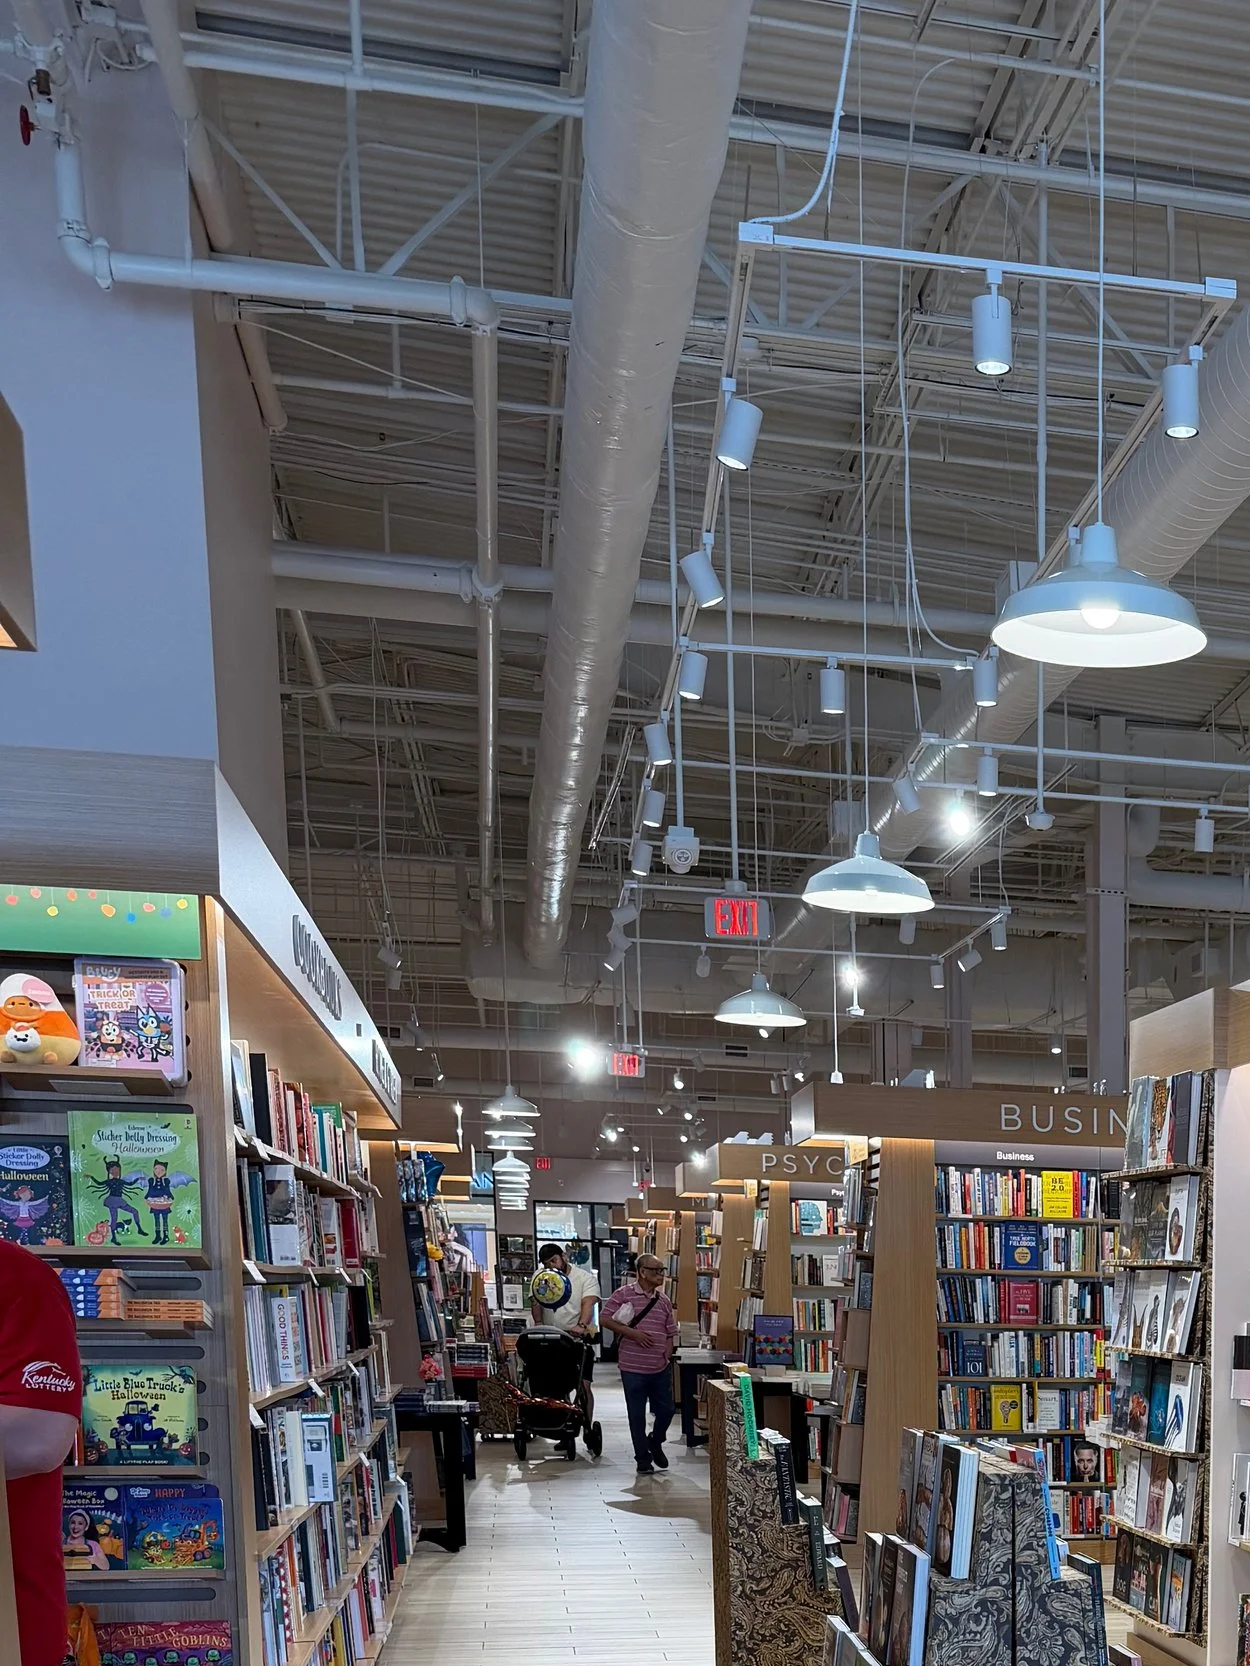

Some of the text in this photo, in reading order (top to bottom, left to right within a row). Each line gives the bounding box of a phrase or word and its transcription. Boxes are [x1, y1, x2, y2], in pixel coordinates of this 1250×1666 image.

[714, 899, 759, 936] EXIT
[90, 989, 136, 999] TRICK OR
[613, 1053, 638, 1075] EXIT
[1000, 1103, 1128, 1135] BUSIN
[97, 1130, 177, 1145] Sticker Dolly Dressing
[112, 1141, 164, 1153] Halloween
[5, 1159, 38, 1167] Dressing
[26, 1153, 44, 1162] Dolly
[996, 1152, 1035, 1162] Business
[762, 1153, 843, 1176] PSYC
[277, 1303, 290, 1361] GOOD THINGS
[967, 1362, 982, 1373] 101
[21, 1372, 76, 1391] Kentucky
[26, 1383, 74, 1392] LOTTERY
[94, 1378, 185, 1393] Little Blue Truck's
[112, 1390, 166, 1400] Halloween
[76, 1490, 96, 1498] Magic
[155, 1488, 185, 1498] HAPPY
[118, 1625, 145, 1638] TEN
[132, 1627, 179, 1646] LITTLE
[172, 1636, 227, 1648] GOBLINS
